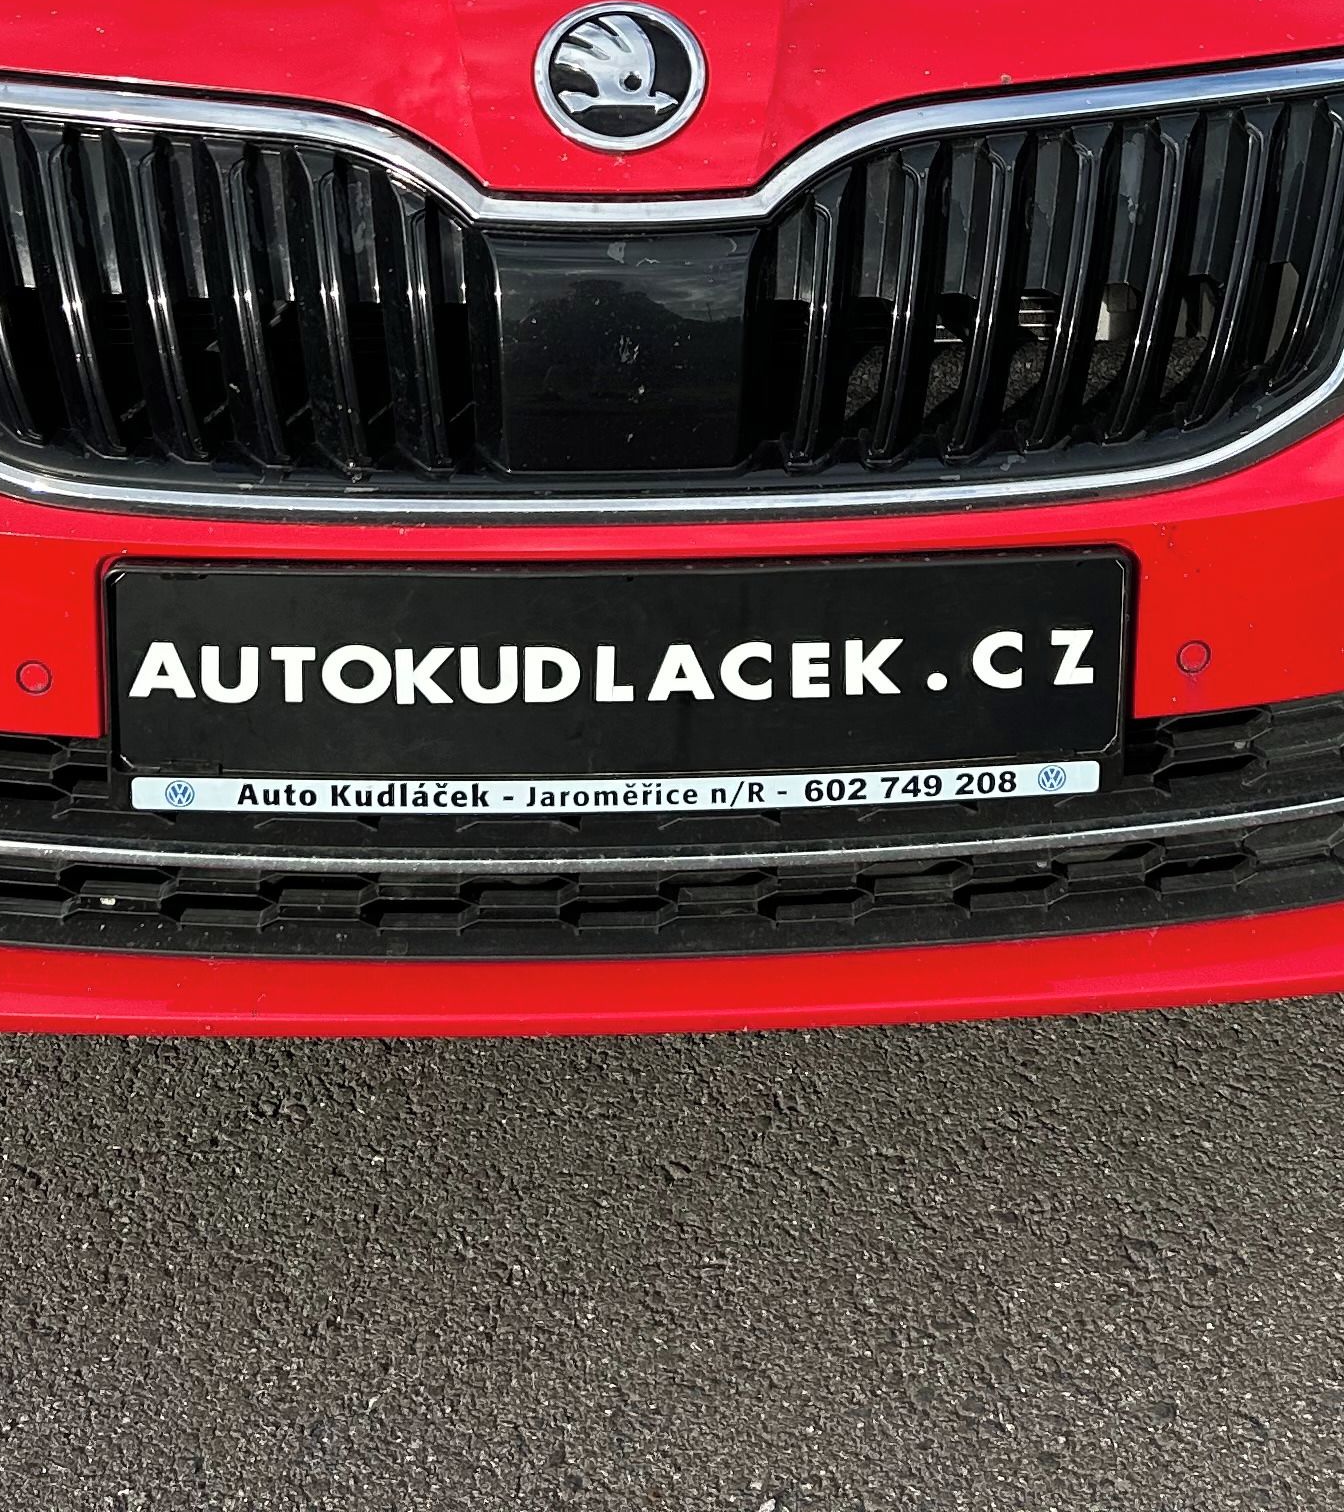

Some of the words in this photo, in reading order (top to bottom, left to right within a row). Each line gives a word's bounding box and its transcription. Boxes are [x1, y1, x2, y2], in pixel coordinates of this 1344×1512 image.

[237, 783, 317, 807] Auto
[330, 782, 490, 808] Kudláček
[526, 782, 698, 807] Jaroměřice
[711, 780, 765, 808] n/R
[804, 777, 867, 803] 602
[880, 774, 943, 799] 749
[954, 770, 1017, 796] 208
